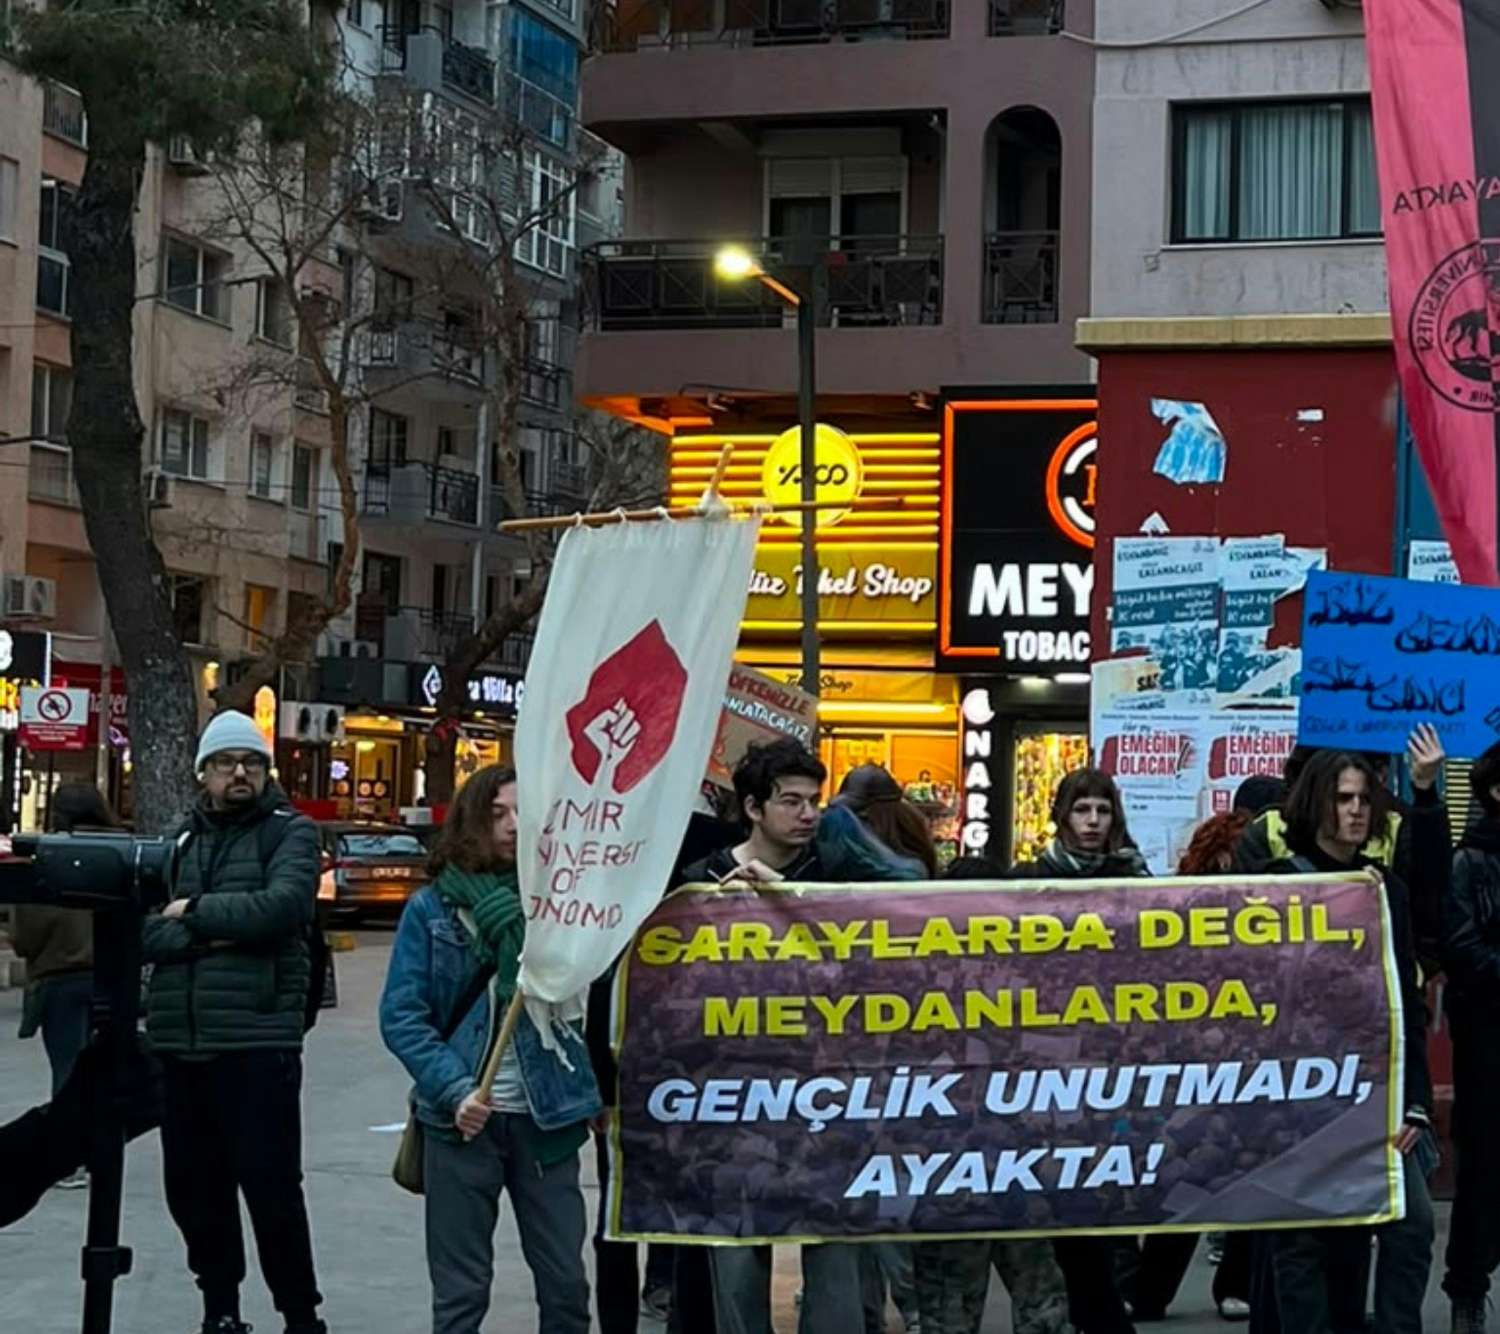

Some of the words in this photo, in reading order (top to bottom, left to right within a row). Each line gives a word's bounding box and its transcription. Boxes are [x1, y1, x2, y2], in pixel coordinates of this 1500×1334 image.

[792, 565, 858, 595] Tkel
[863, 563, 933, 603] Shop
[1003, 630, 1091, 662] TOBAC
[1121, 730, 1176, 754] EMEĞİN
[1229, 730, 1285, 755] EMEĞİN
[962, 730, 992, 857] NARG
[636, 911, 1114, 965] SARAYLARDA
[1139, 894, 1368, 953] DEĞİL,
[703, 979, 1279, 1038] MEYDANLARDA,
[646, 1064, 963, 1134] GENÇLİK
[983, 1053, 1375, 1117] UNUTMADI,
[843, 1144, 1162, 1201] AYAKTA!
